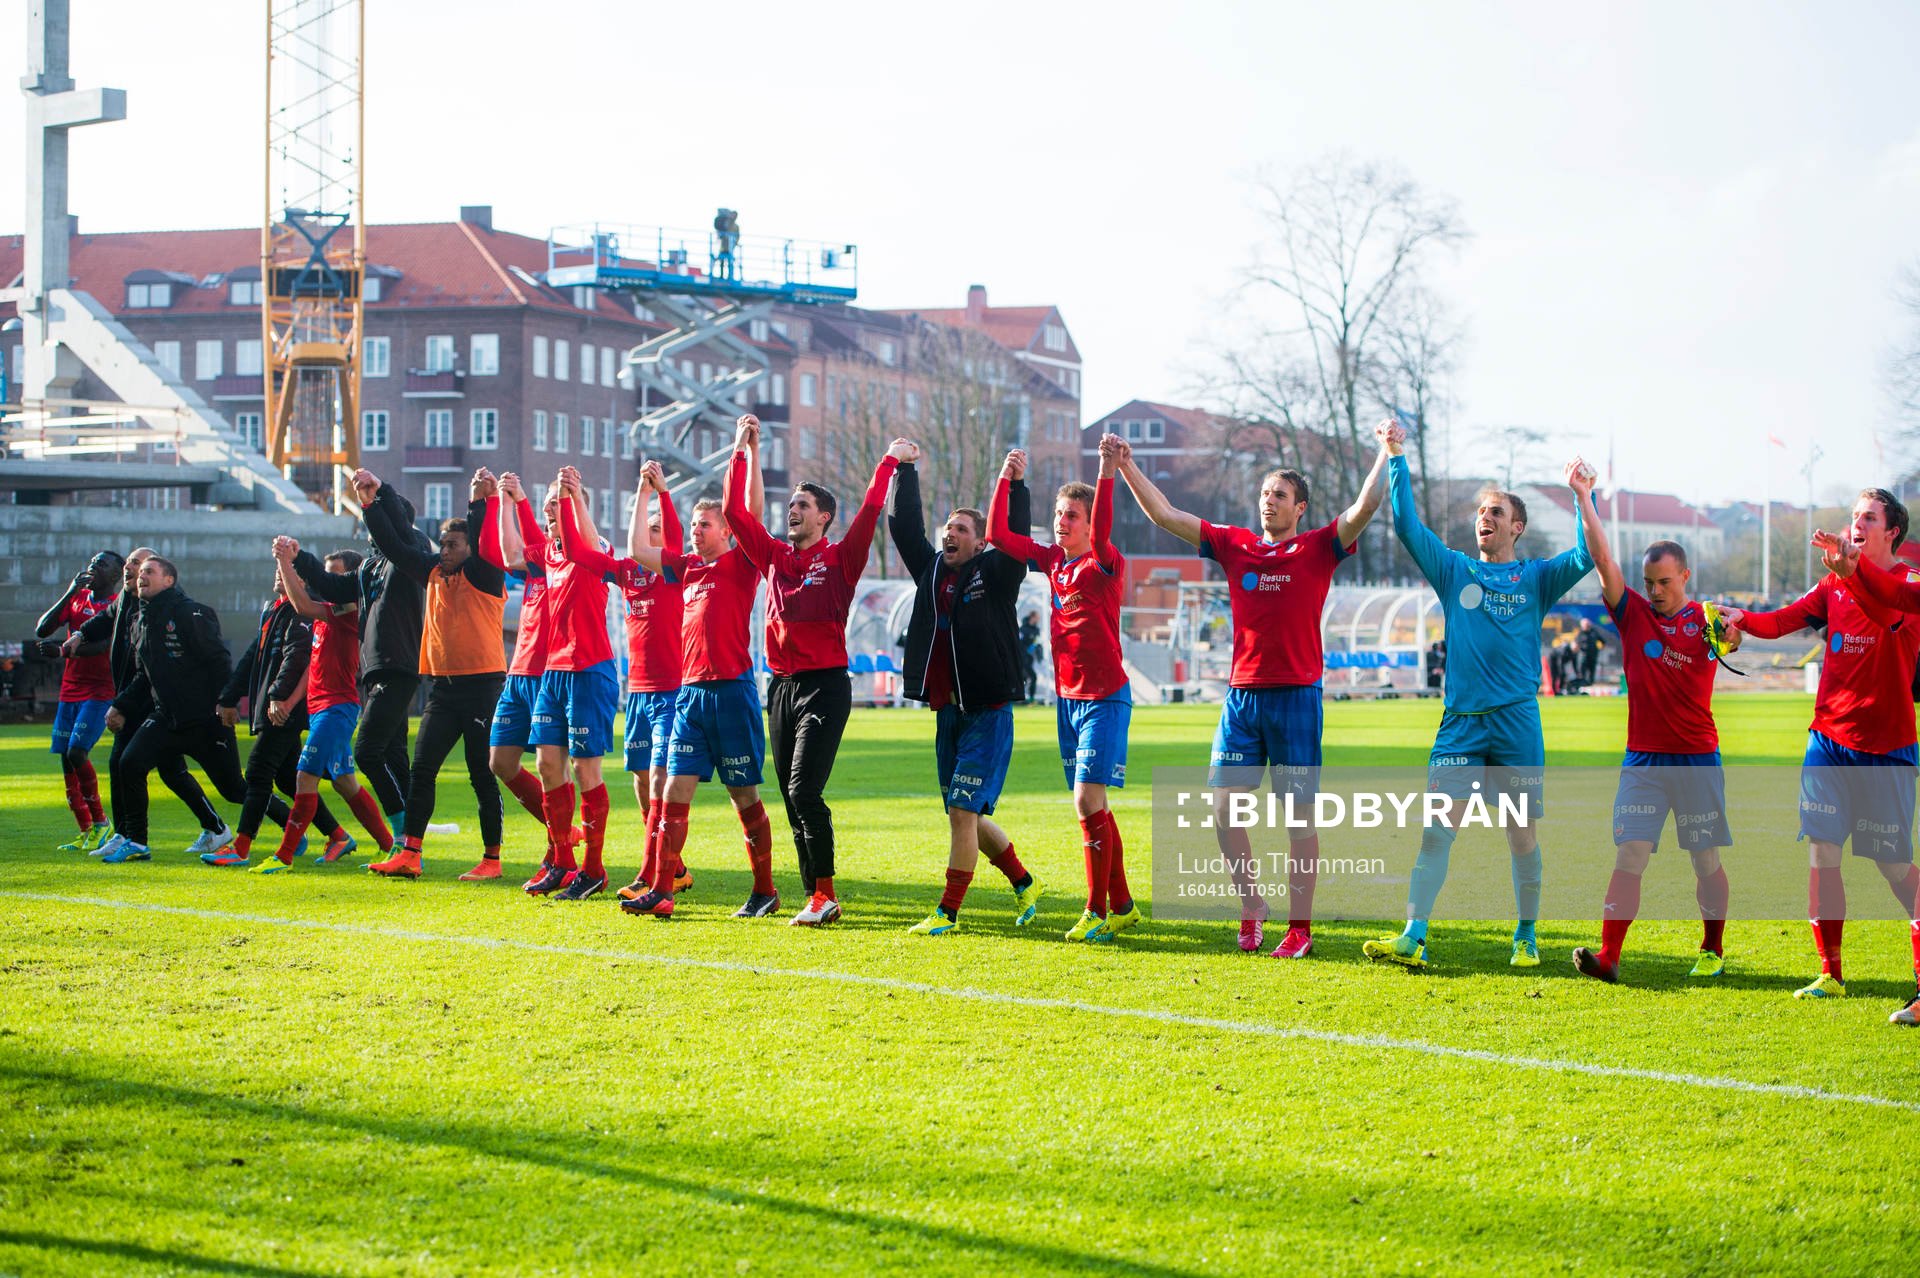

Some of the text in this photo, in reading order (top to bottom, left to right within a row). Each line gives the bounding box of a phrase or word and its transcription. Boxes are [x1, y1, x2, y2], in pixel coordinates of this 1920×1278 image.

[1260, 573, 1291, 582] Resurs
[1259, 582, 1281, 591] Bank
[1485, 590, 1526, 603] Resurs
[1484, 601, 1514, 616] Bank
[1843, 633, 1875, 644] Resurs
[1843, 643, 1864, 653] Bank
[1664, 646, 1692, 664] Resurs
[1662, 655, 1682, 670] Bank
[1437, 756, 1468, 767] SOLID
[953, 774, 982, 786] SOLID
[952, 788, 959, 799] 8
[1620, 805, 1656, 814] SOLID
[1802, 801, 1836, 814] SOLID
[1688, 811, 1719, 824] SOLID
[1868, 821, 1899, 833] SOLID
[1689, 830, 1699, 842] 20
[1873, 838, 1880, 852] 11
